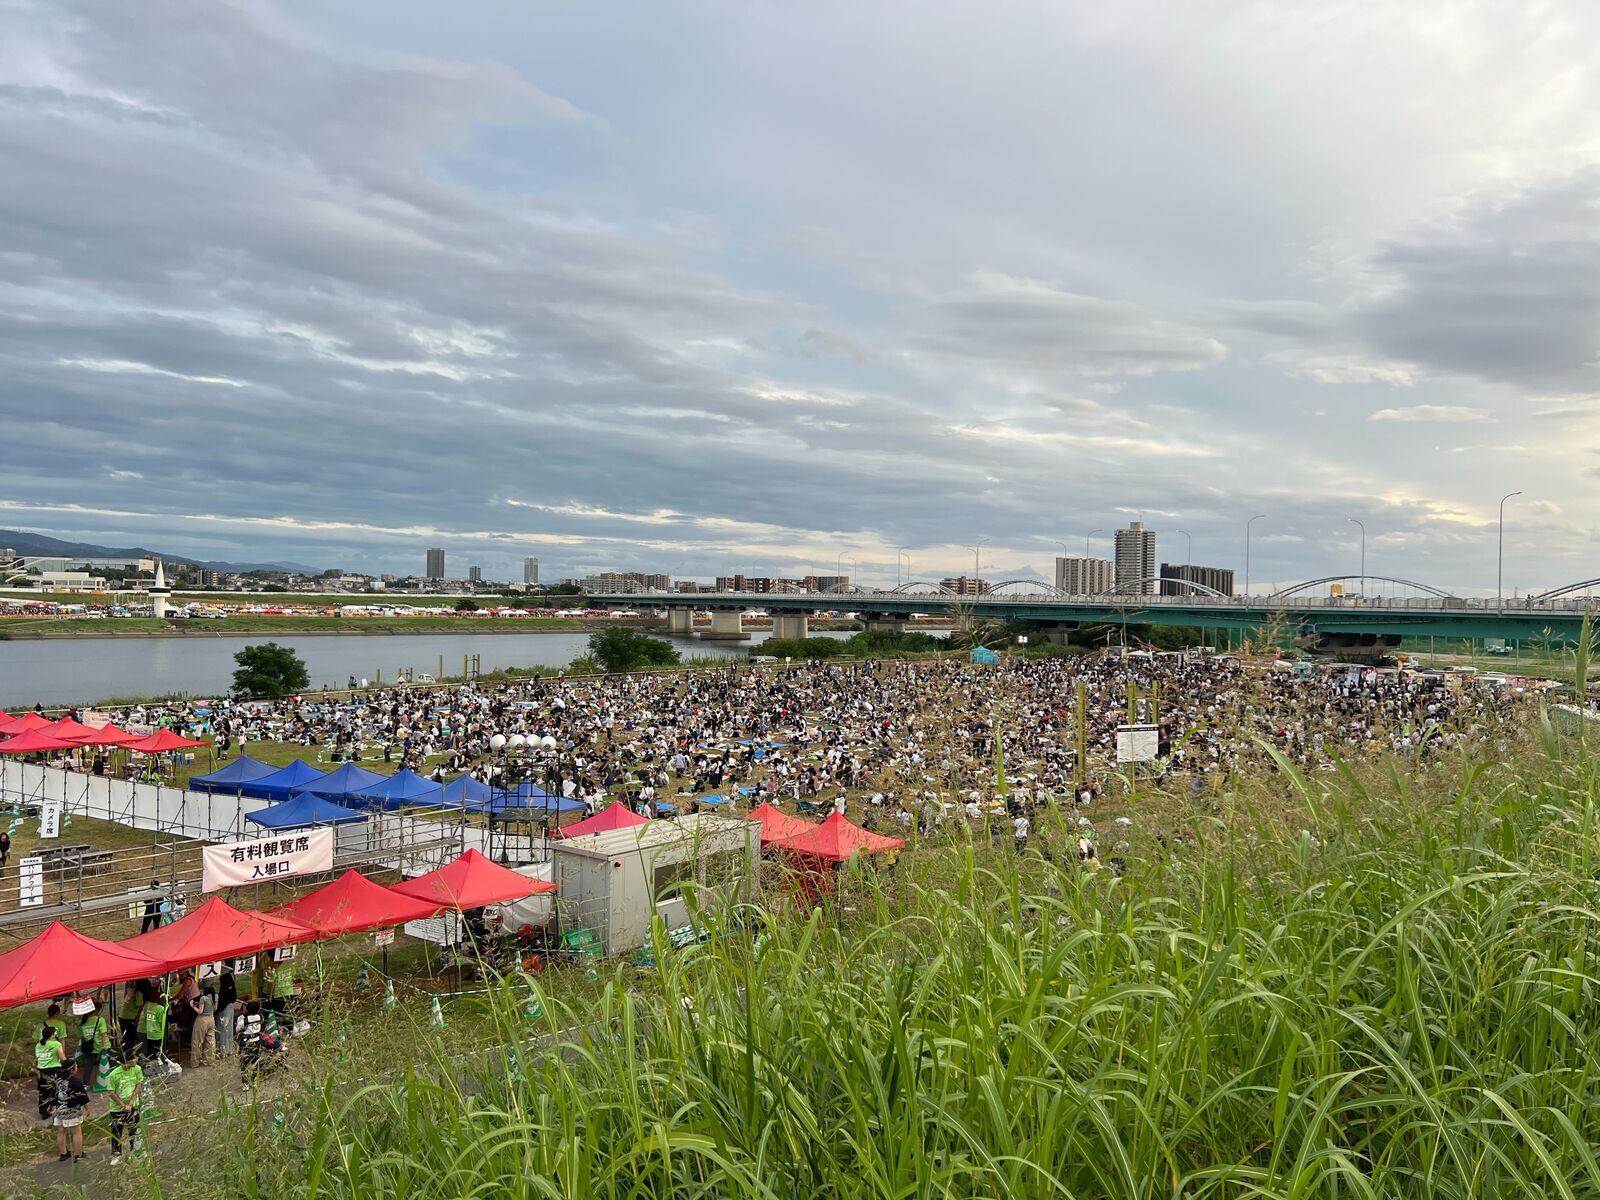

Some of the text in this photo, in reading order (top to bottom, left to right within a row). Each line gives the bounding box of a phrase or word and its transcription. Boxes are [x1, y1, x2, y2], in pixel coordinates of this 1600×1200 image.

[46, 807, 55, 834] カメラ席
[230, 836, 310, 862] 有料観覧席
[252, 861, 290, 878] 入場口
